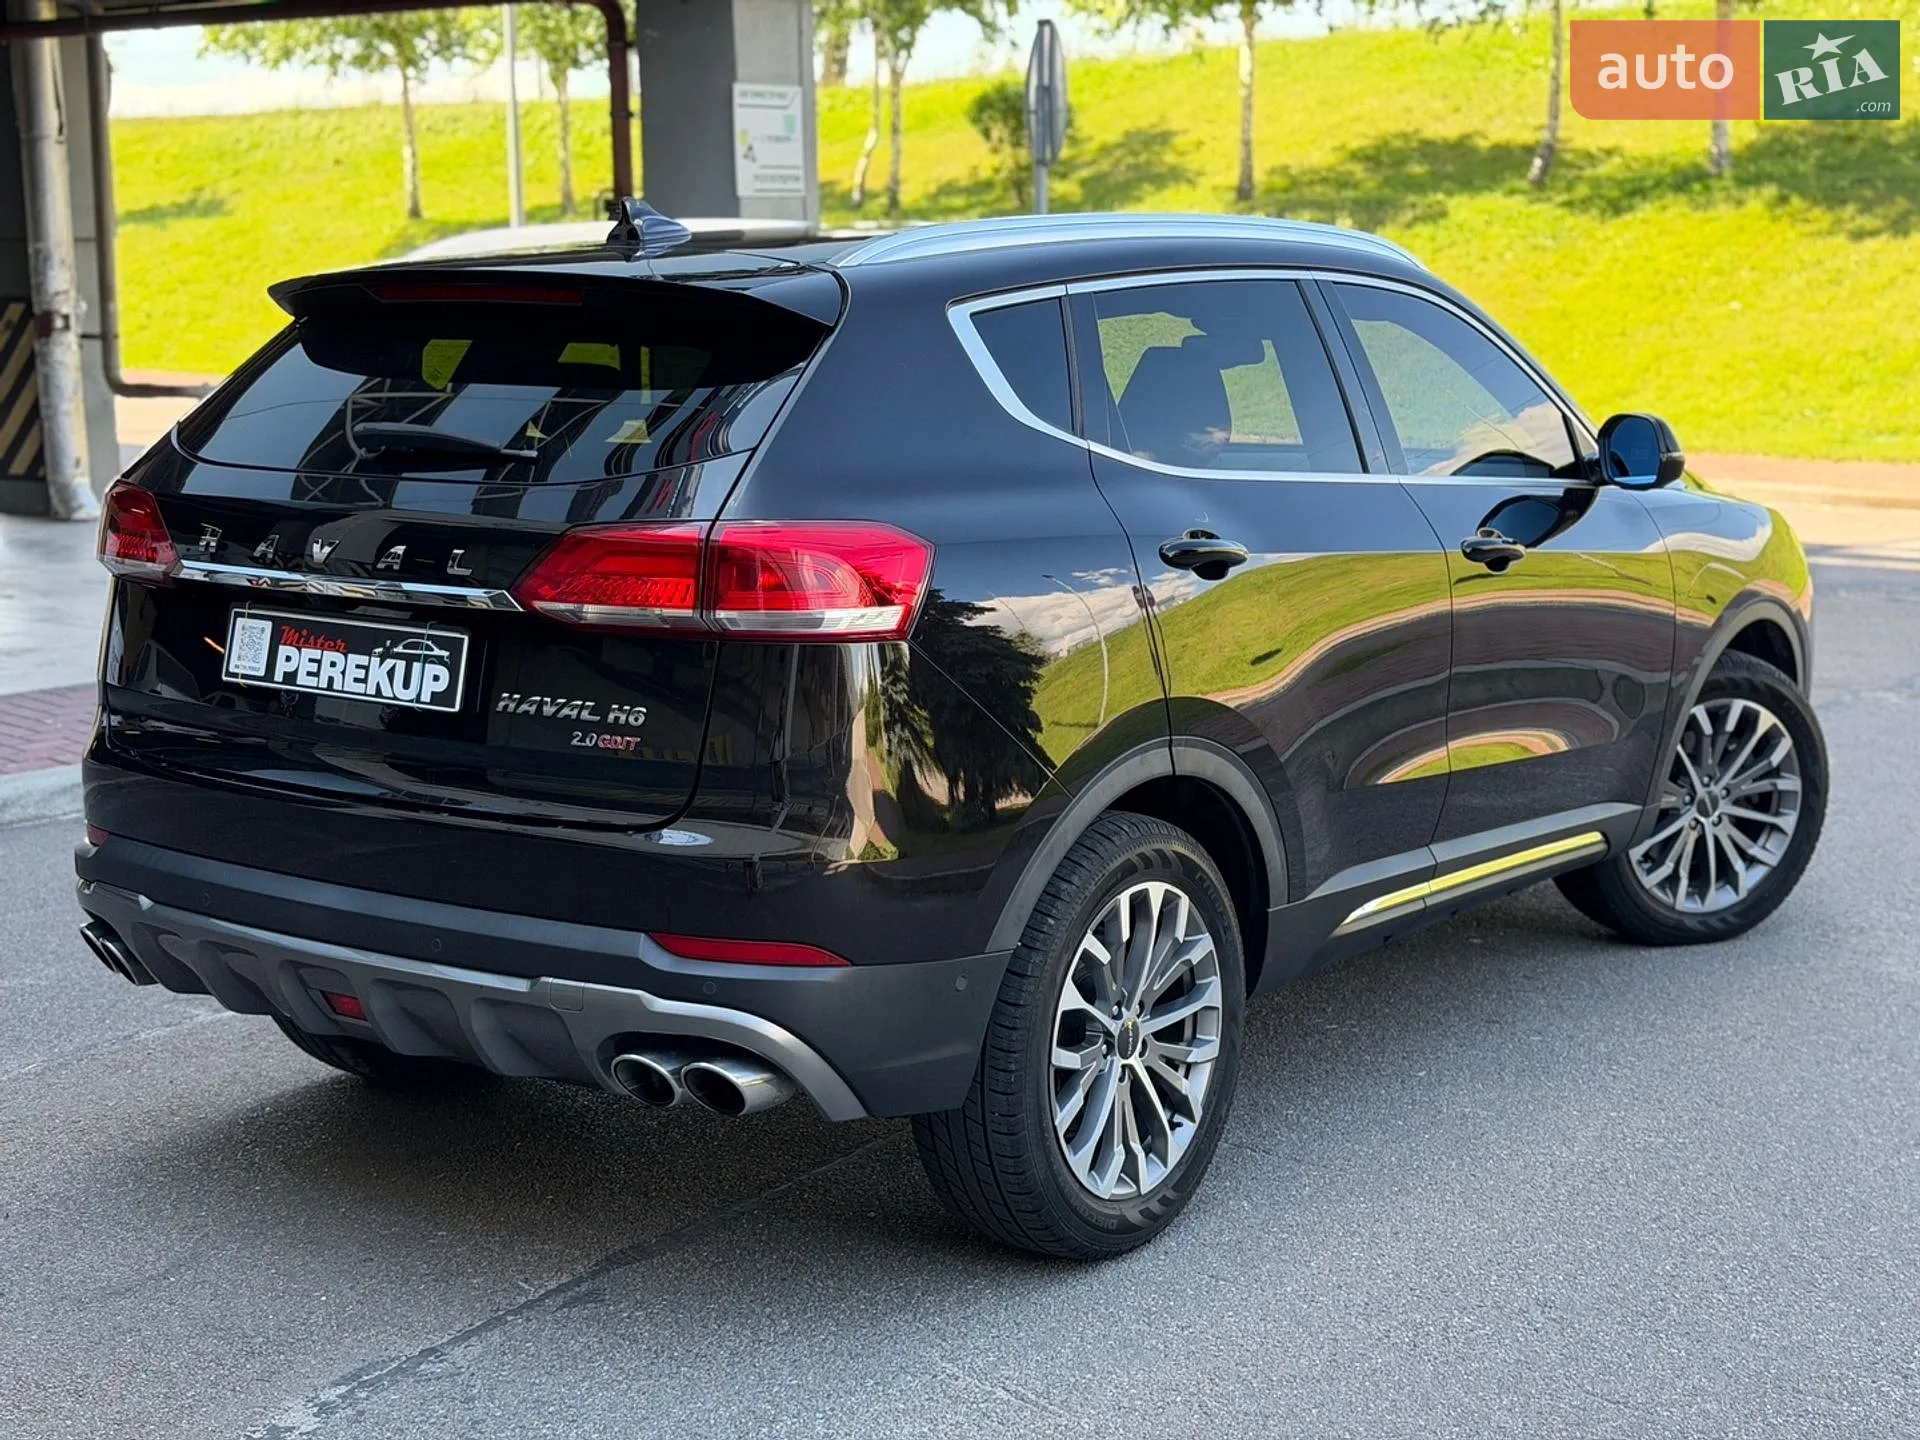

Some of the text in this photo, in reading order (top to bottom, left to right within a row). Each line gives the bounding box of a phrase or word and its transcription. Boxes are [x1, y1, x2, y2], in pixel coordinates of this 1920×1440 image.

[198, 522, 473, 576] HAVAL
[279, 625, 347, 653] Mister
[273, 645, 450, 703] PEREKUP
[495, 692, 648, 727] HAVAL H6
